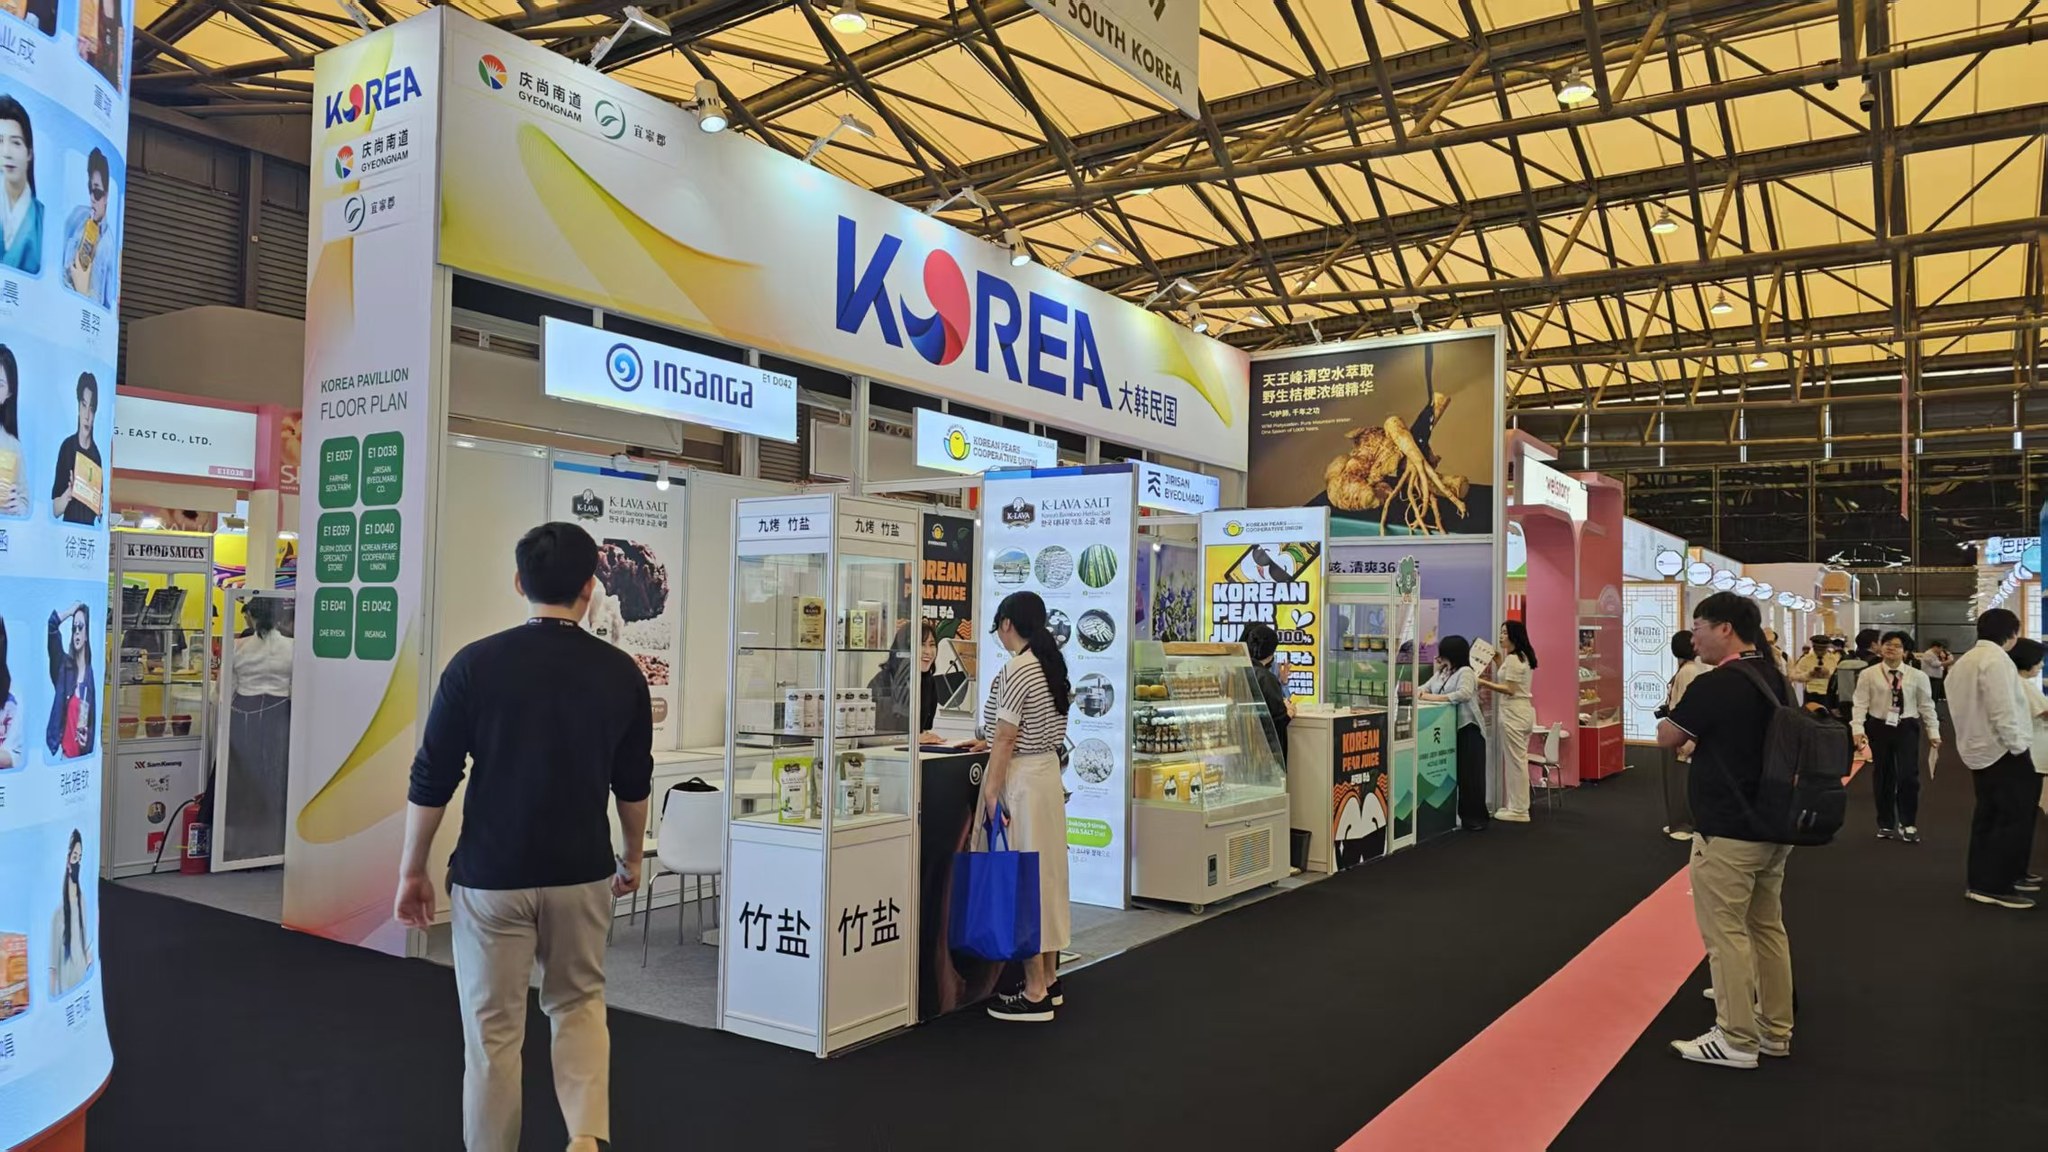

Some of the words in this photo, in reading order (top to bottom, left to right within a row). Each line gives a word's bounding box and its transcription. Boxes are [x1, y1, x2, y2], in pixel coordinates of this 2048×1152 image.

[1068, 0, 1126, 53] SOUTH
[1132, 38, 1183, 95] KOREA
[325, 66, 422, 129] KOREA
[519, 71, 582, 110] 庆尚南道
[518, 91, 582, 123] GYEONGNAM
[362, 129, 409, 159] 庆尚南道
[361, 150, 409, 172] GYEONGNAM
[836, 215, 1113, 410] KOREA
[321, 376, 355, 393] KOREA
[357, 368, 409, 388] PAVILLION
[762, 373, 771, 384] E1
[773, 375, 792, 389] D042
[1263, 363, 1374, 388] 天王峰清空水萃取
[1262, 380, 1374, 404] 野生桔梗浓缩精华
[321, 397, 366, 420] FLOOR
[371, 391, 408, 414] PLAN
[1118, 381, 1178, 427] 大韩民国
[129, 428, 157, 439] EAST
[162, 432, 185, 443] CO.,
[189, 436, 212, 446] LTD.
[973, 436, 1000, 450] KOREAN
[1001, 442, 1021, 454] PEARS
[327, 452, 334, 462] E1
[336, 450, 353, 462] E037
[368, 447, 376, 458] E1
[378, 445, 397, 457] D038
[973, 447, 1017, 464] COOPERATIVE
[1165, 474, 1190, 489] JIRISAN
[577, 503, 599, 513] K-LAVA
[609, 496, 644, 510] K-LAVA
[646, 500, 668, 513] SALT
[1042, 499, 1081, 511] K-LAVA
[1084, 497, 1112, 509] SALT
[758, 518, 780, 533] 九烤
[787, 517, 810, 531] 竹盐
[1007, 512, 1030, 520] K-LAVA
[324, 526, 331, 536] E1
[332, 525, 350, 536] E039
[365, 524, 373, 534] E1
[375, 523, 394, 534] D040
[855, 518, 874, 534] 九烤
[881, 522, 900, 537] 竹盐
[128, 543, 168, 557] K-FOOD
[170, 544, 204, 559] SAUCES
[904, 559, 967, 583] KREAN
[1329, 560, 1419, 574] 咳、清爽36
[936, 585, 966, 601] JUICE
[1213, 582, 1306, 602] KOREAN
[321, 601, 329, 611] E1
[330, 601, 346, 611] E041
[362, 601, 370, 611] E1
[371, 601, 391, 611] D042
[1213, 603, 1274, 623] PEAR
[1288, 679, 1313, 687] ATER
[1342, 728, 1379, 754] KOREAN
[1342, 755, 1360, 772] PEAR
[1361, 752, 1379, 768] JUICE
[739, 901, 811, 958] 竹盐
[838, 897, 900, 956] 竹盐
